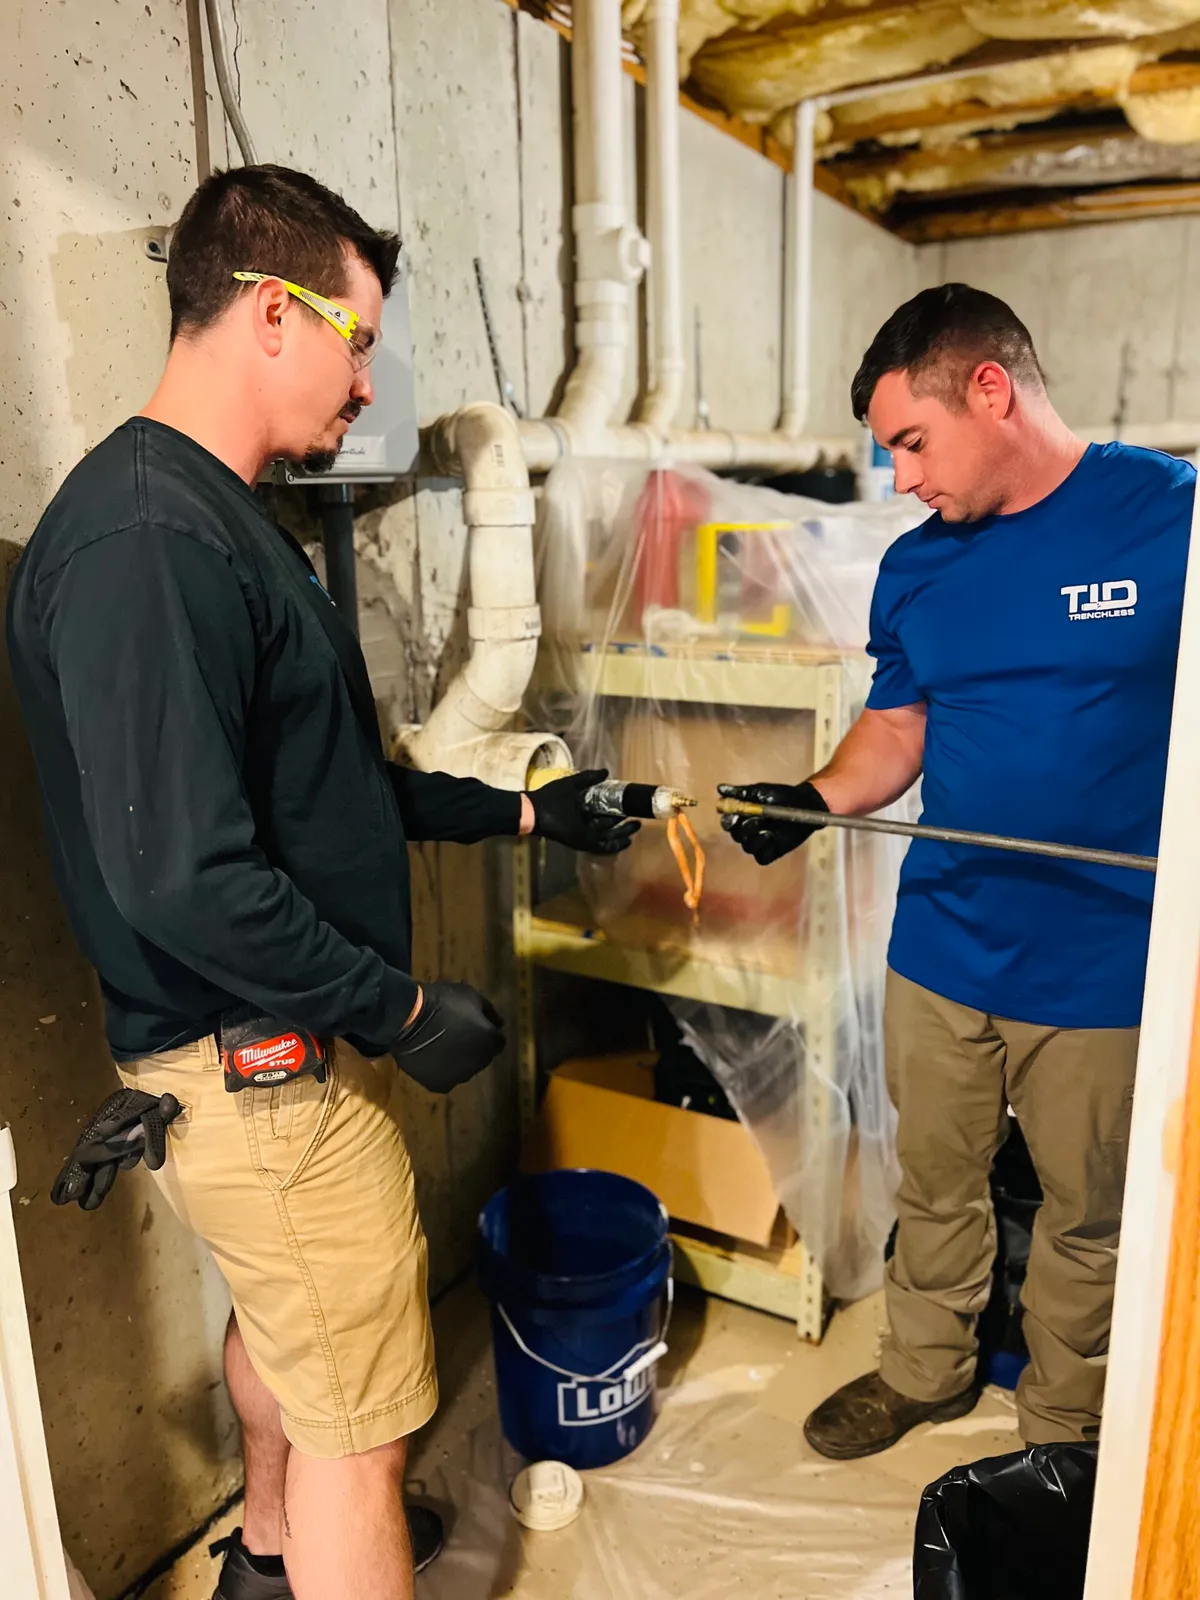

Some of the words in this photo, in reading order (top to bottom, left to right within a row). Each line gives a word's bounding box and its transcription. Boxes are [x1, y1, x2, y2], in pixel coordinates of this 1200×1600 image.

[1069, 608, 1135, 621] TRENCHLESS
[238, 1038, 298, 1064] Milwaukee
[269, 1058, 296, 1067] STUD
[576, 1368, 654, 1418] LOW
